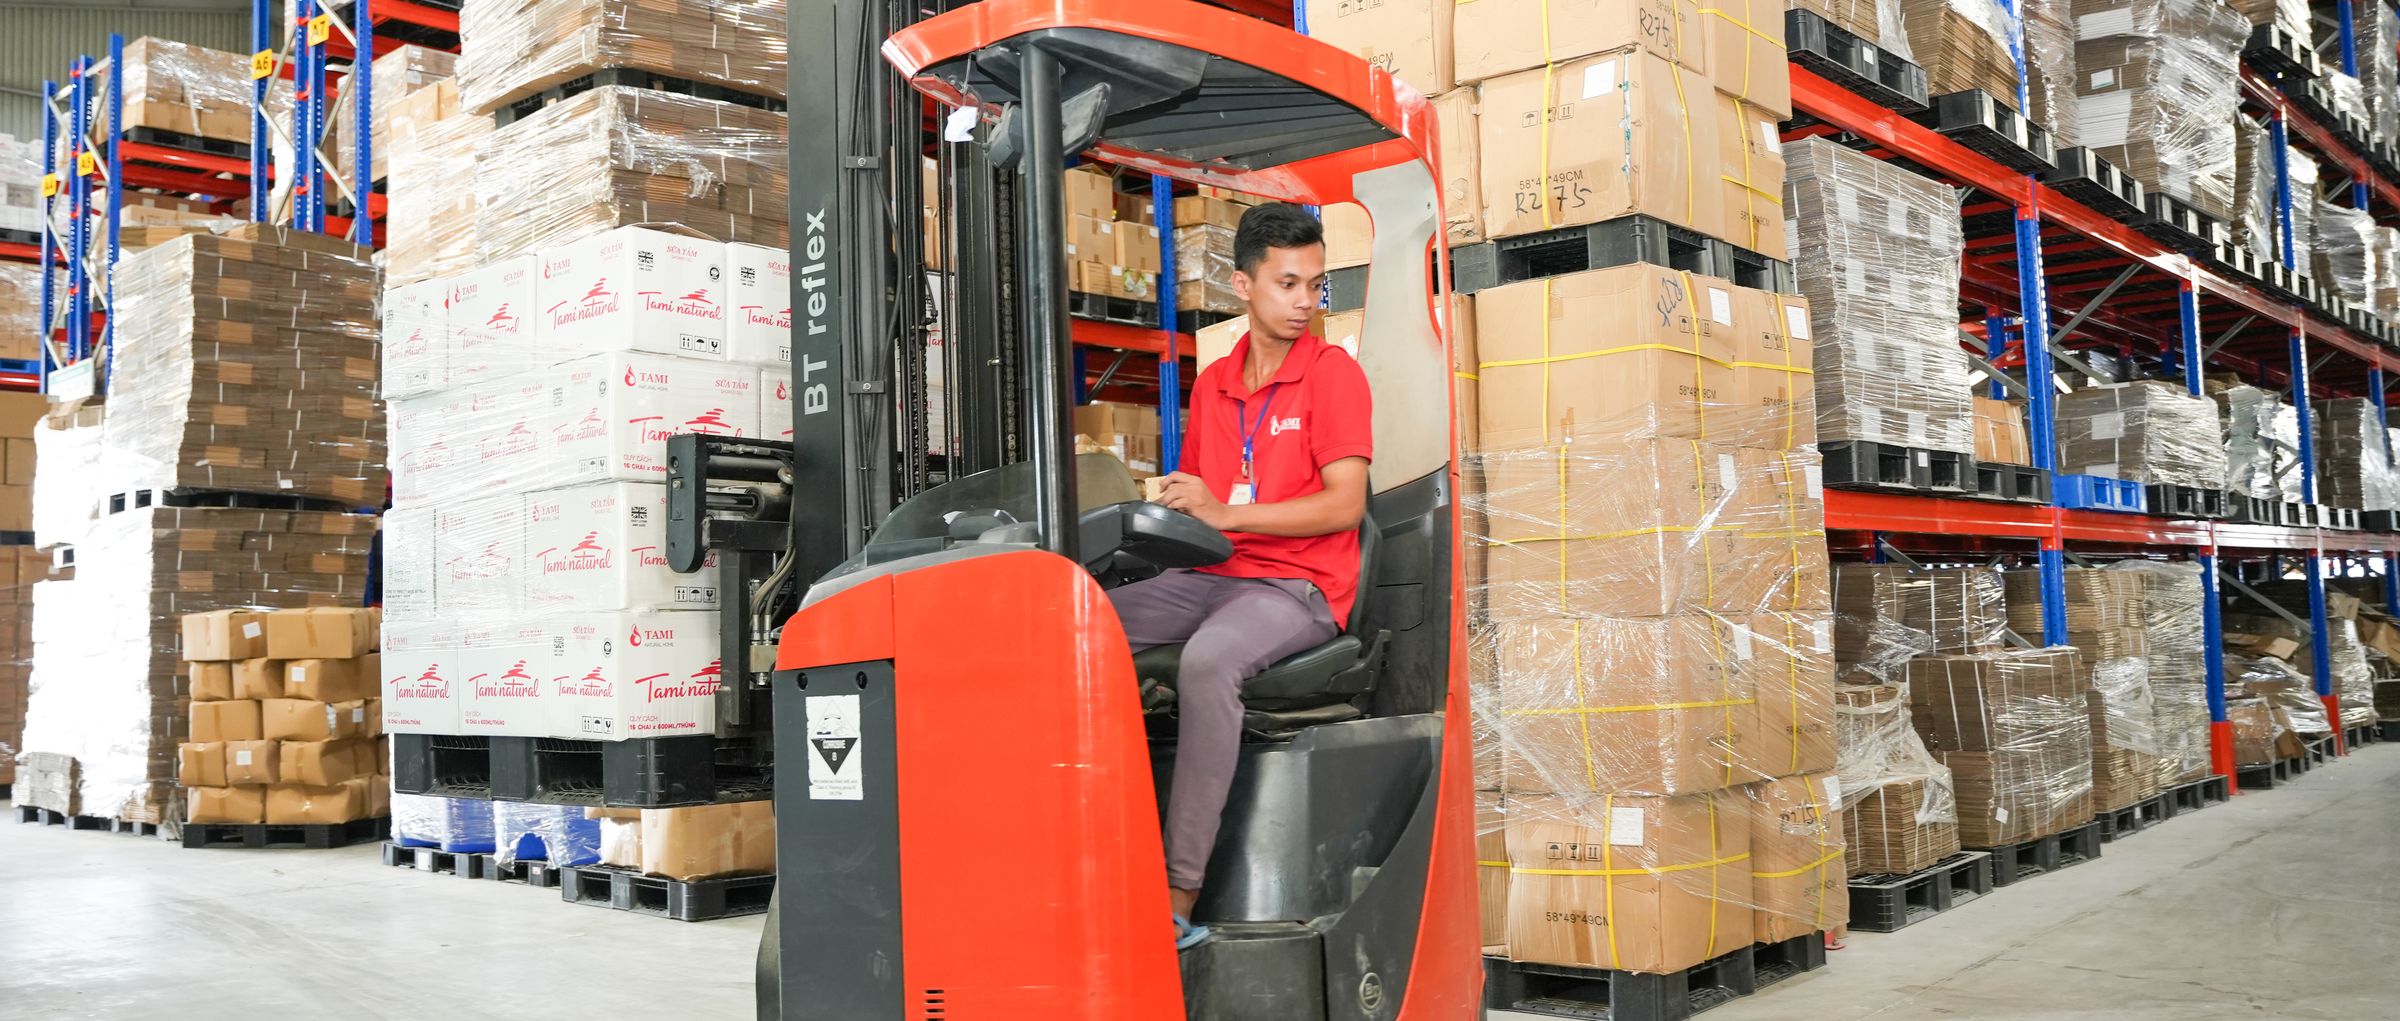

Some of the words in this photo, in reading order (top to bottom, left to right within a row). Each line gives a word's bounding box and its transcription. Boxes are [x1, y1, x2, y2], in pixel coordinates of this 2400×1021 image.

[256, 56, 269, 70] A6
[1515, 182, 1592, 218] R275
[552, 258, 571, 271] TAMI
[801, 207, 827, 336] reflex
[461, 283, 478, 296] TAMI
[547, 301, 577, 331] Tami
[578, 291, 620, 320] natural
[638, 291, 674, 313] Tami
[676, 301, 722, 321] natural
[740, 306, 774, 326] Tami
[639, 372, 669, 384] TAMI
[803, 353, 828, 415] BT
[536, 547, 567, 576] Tami
[569, 549, 612, 571] natural
[644, 630, 674, 640] TAMI
[390, 676, 415, 701] Tami
[416, 680, 450, 699] natural
[468, 673, 499, 701] Tami
[500, 678, 540, 698] natural
[553, 676, 578, 697] Tami
[579, 682, 614, 698] natural
[635, 673, 686, 703] Tami
